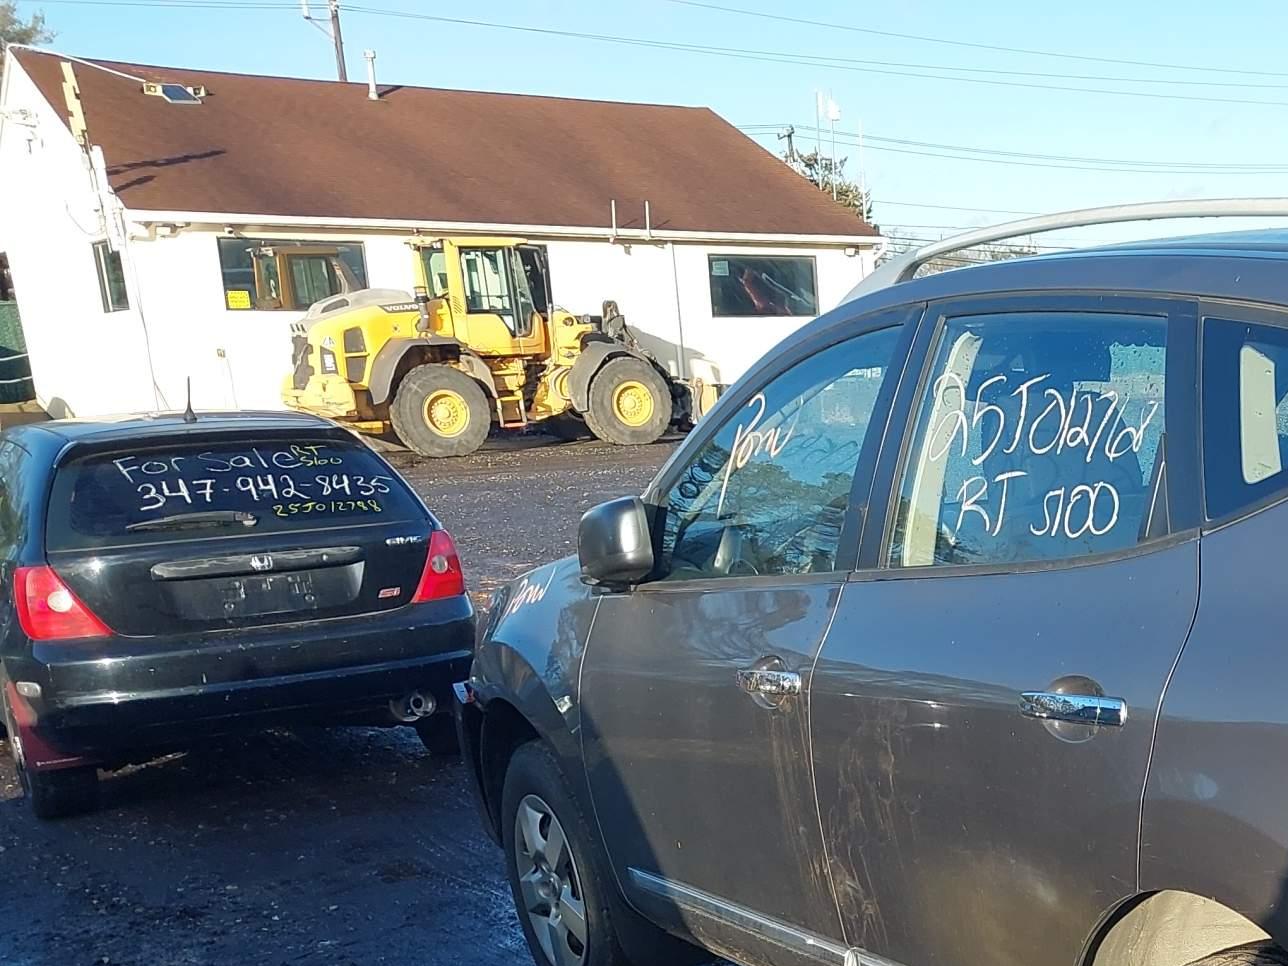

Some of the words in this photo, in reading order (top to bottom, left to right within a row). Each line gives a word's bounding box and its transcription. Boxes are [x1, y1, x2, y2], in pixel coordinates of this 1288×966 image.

[384, 304, 418, 312] VOLVO
[112, 456, 185, 483] For
[197, 448, 303, 469] Sale
[290, 445, 327, 457] RT
[136, 474, 394, 512] 347-942-8435
[949, 470, 1028, 545] RT
